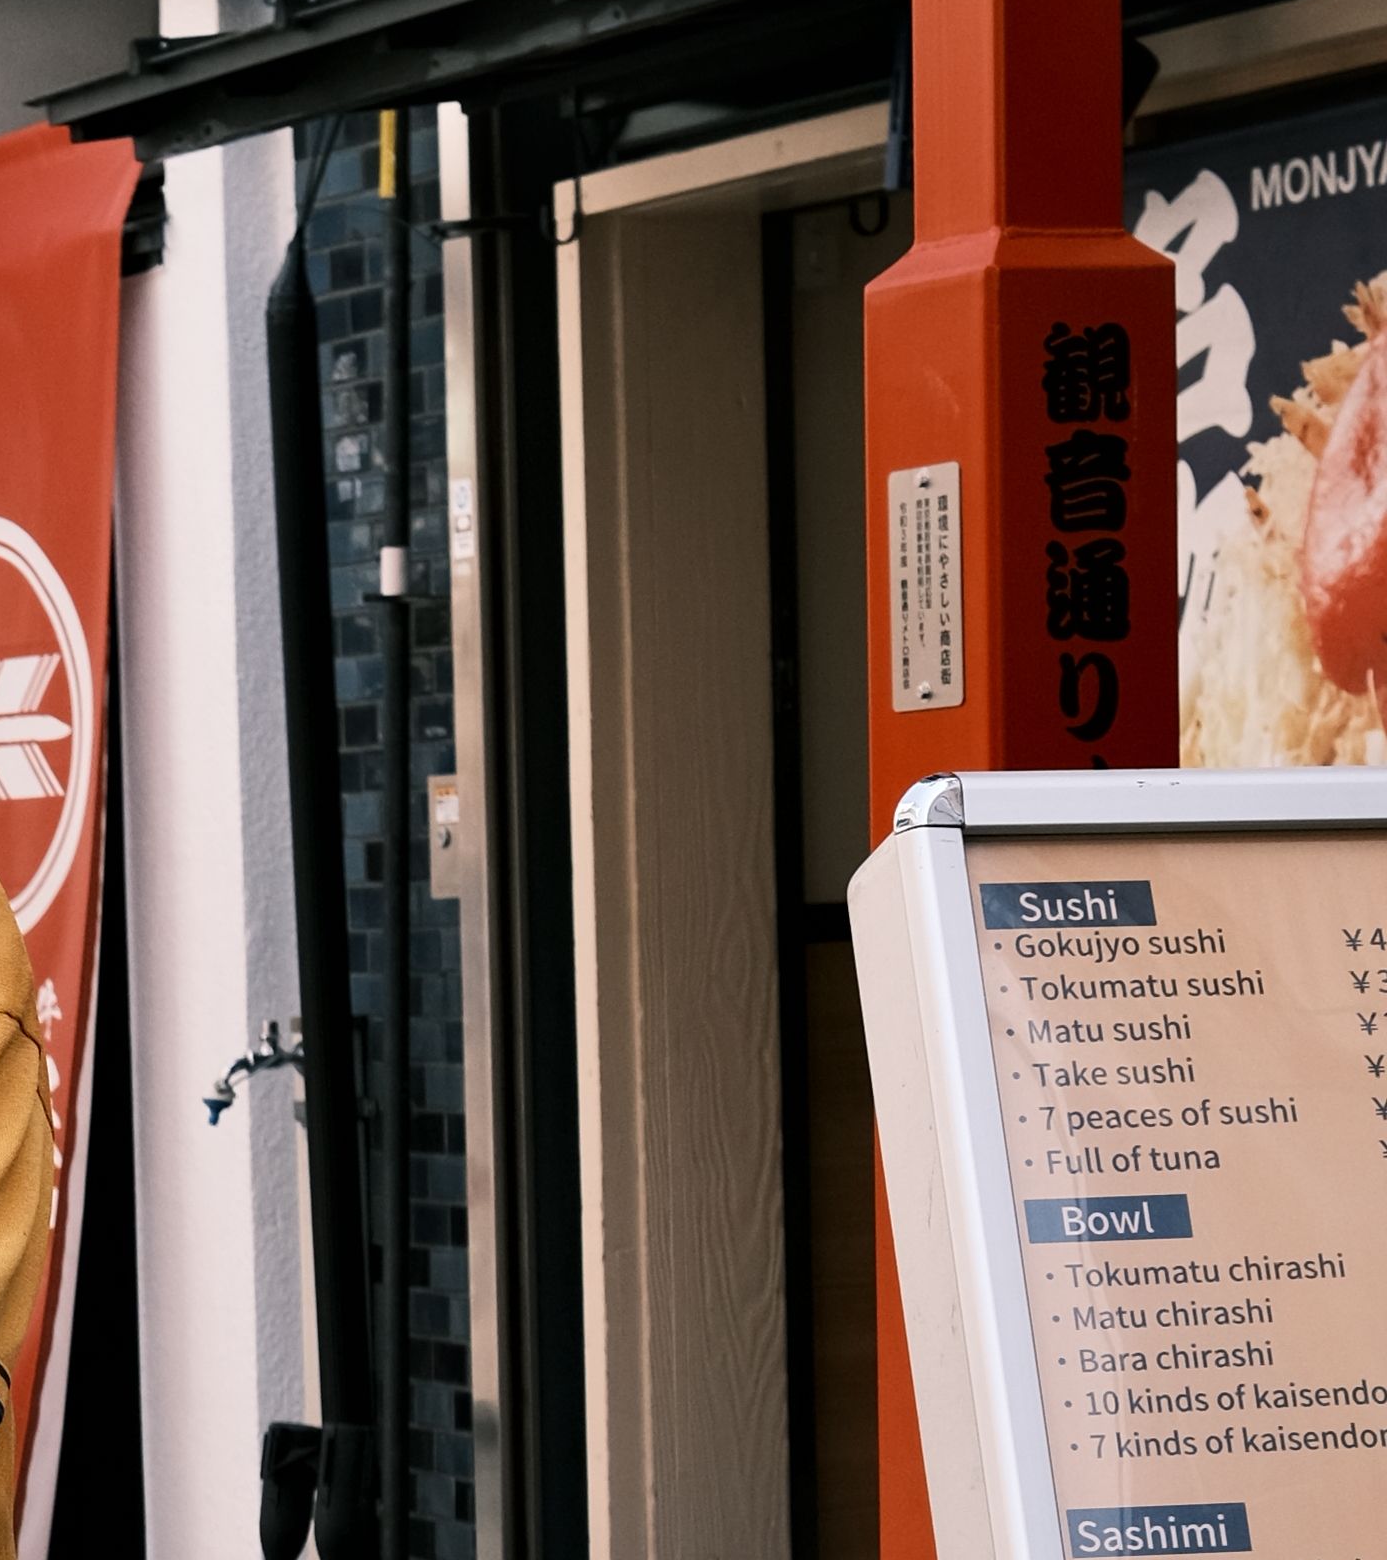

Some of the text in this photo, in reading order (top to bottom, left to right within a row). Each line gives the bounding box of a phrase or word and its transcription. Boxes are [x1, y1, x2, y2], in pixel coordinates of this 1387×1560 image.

[1043, 321, 1131, 768] 観音通り
[1020, 890, 1118, 921] Sushi
[1015, 931, 1139, 963] Gokujyo
[1149, 928, 1225, 955] sushi
[1019, 974, 1178, 1000] Tokumatu
[1187, 970, 1264, 996] sushi
[1028, 1020, 1103, 1043] Matu
[1113, 1014, 1191, 1041] sushi
[1032, 1060, 1107, 1087] Take
[1116, 1057, 1195, 1085] sushi
[1039, 1107, 1055, 1130] 7
[1067, 1108, 1173, 1136] peaces
[1181, 1099, 1210, 1126] of
[1219, 1097, 1297, 1125] sushi
[1047, 1145, 1220, 1174] Full of tuna
[1062, 1202, 1154, 1235] Bowl
[1064, 1253, 1345, 1287] Tokumatu chirashi
[1073, 1298, 1273, 1330] Matu chirashi
[1079, 1340, 1273, 1372] Bara chirashi
[1086, 1391, 1119, 1415] 10
[1127, 1386, 1209, 1414] kinds
[1217, 1384, 1245, 1411] of
[1090, 1435, 1105, 1458] 7
[1116, 1430, 1197, 1458] kinds
[1206, 1427, 1234, 1454] of
[1078, 1514, 1227, 1551] Sashimi
